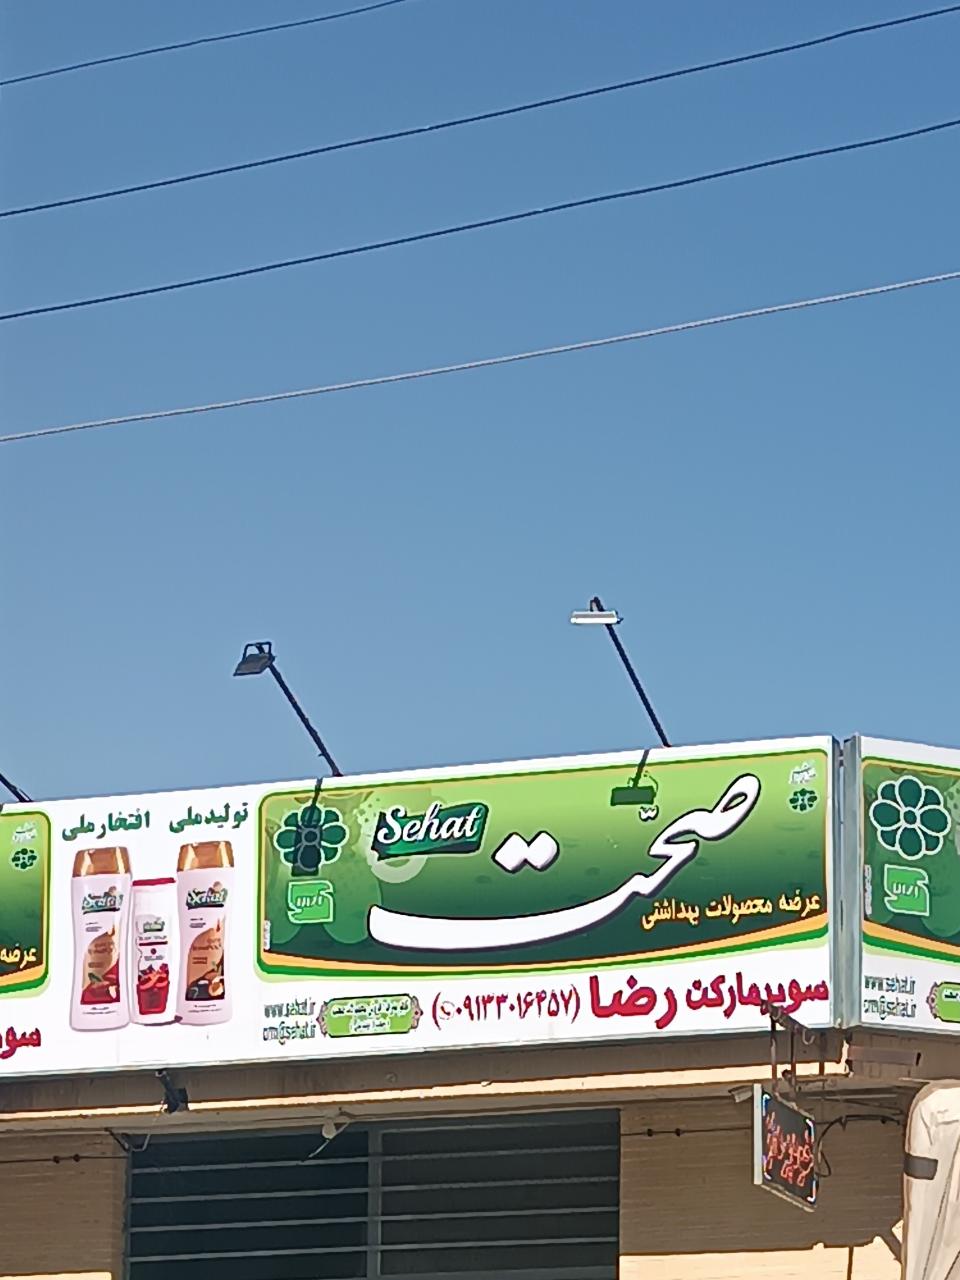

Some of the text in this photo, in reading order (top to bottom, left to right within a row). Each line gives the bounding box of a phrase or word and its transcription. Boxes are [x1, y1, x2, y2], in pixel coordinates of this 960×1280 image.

[377, 801, 481, 844] Sehat
[641, 889, 820, 930] عرضه محصولات بهداشتی
[589, 974, 678, 1029] رضا
